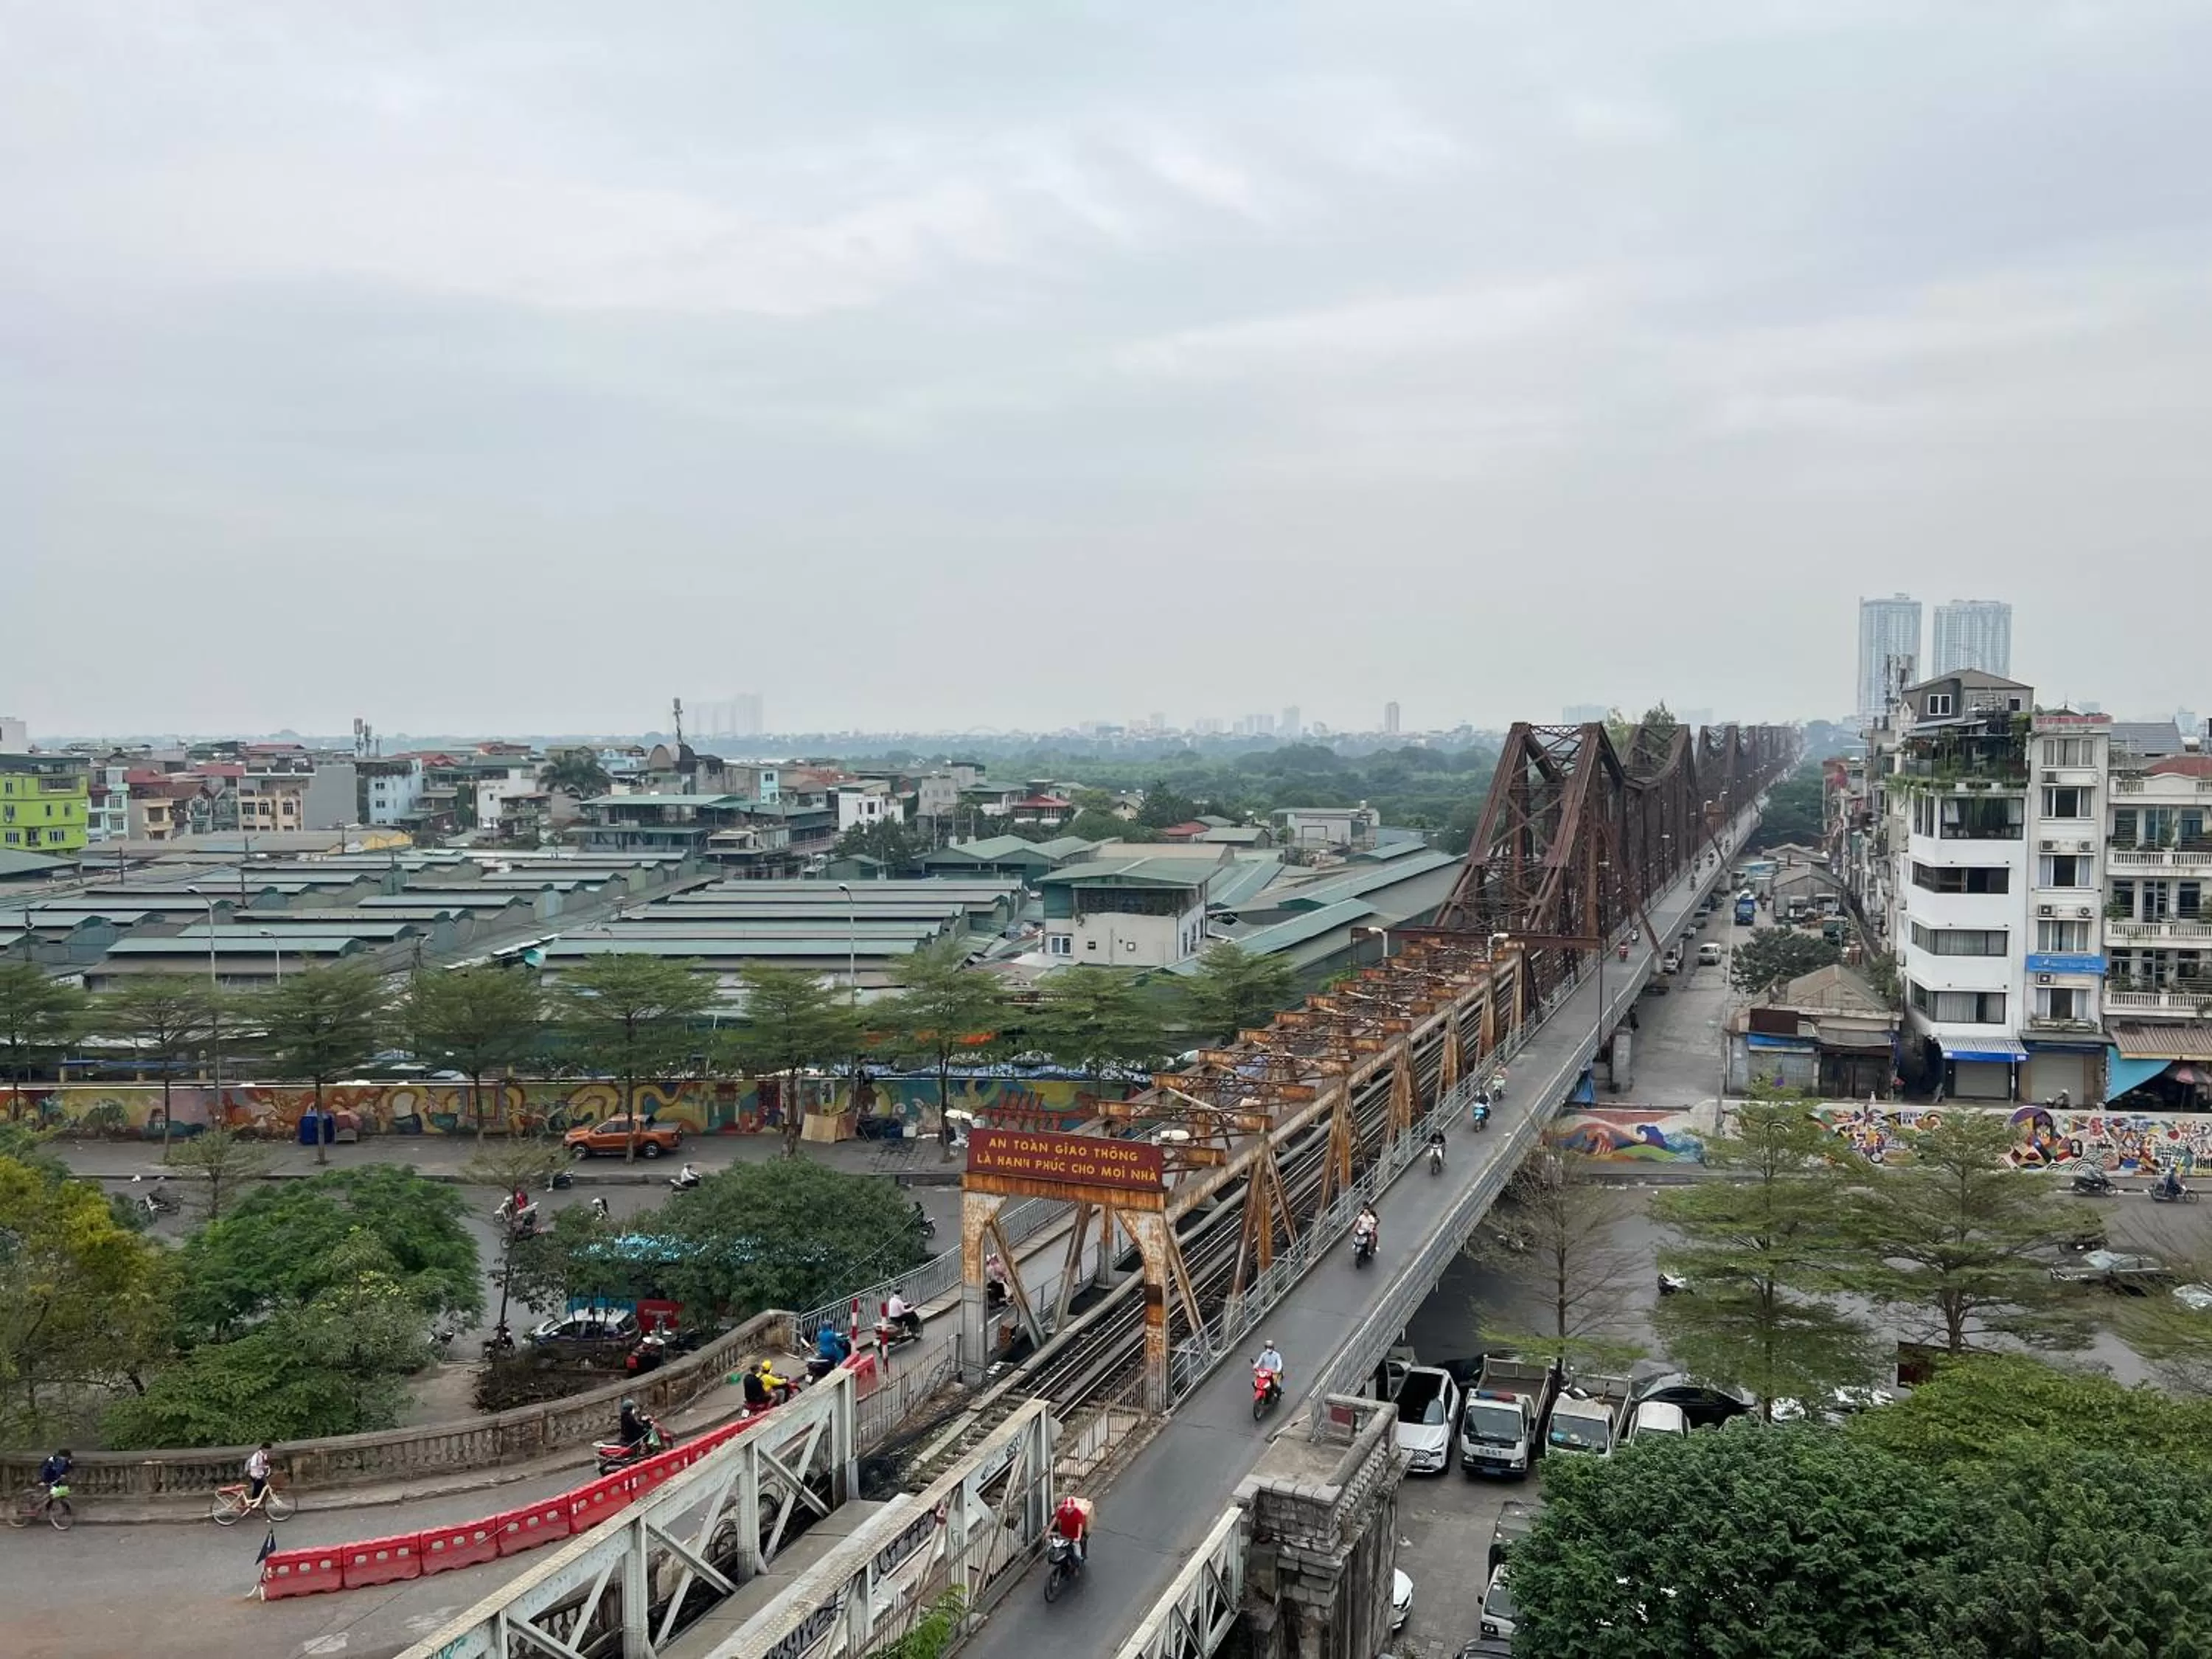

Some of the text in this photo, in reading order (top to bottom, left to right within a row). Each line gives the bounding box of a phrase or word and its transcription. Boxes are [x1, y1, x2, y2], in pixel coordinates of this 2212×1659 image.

[989, 1138, 1007, 1149] AN
[1014, 1138, 1048, 1152] TOÀN
[1094, 1146, 1138, 1161] THÔNG
[977, 1150, 992, 1165] LÀ
[1035, 1156, 1065, 1172] PHÚC
[1071, 1164, 1095, 1175] CHO
[1130, 1166, 1157, 1182] NHÀ
